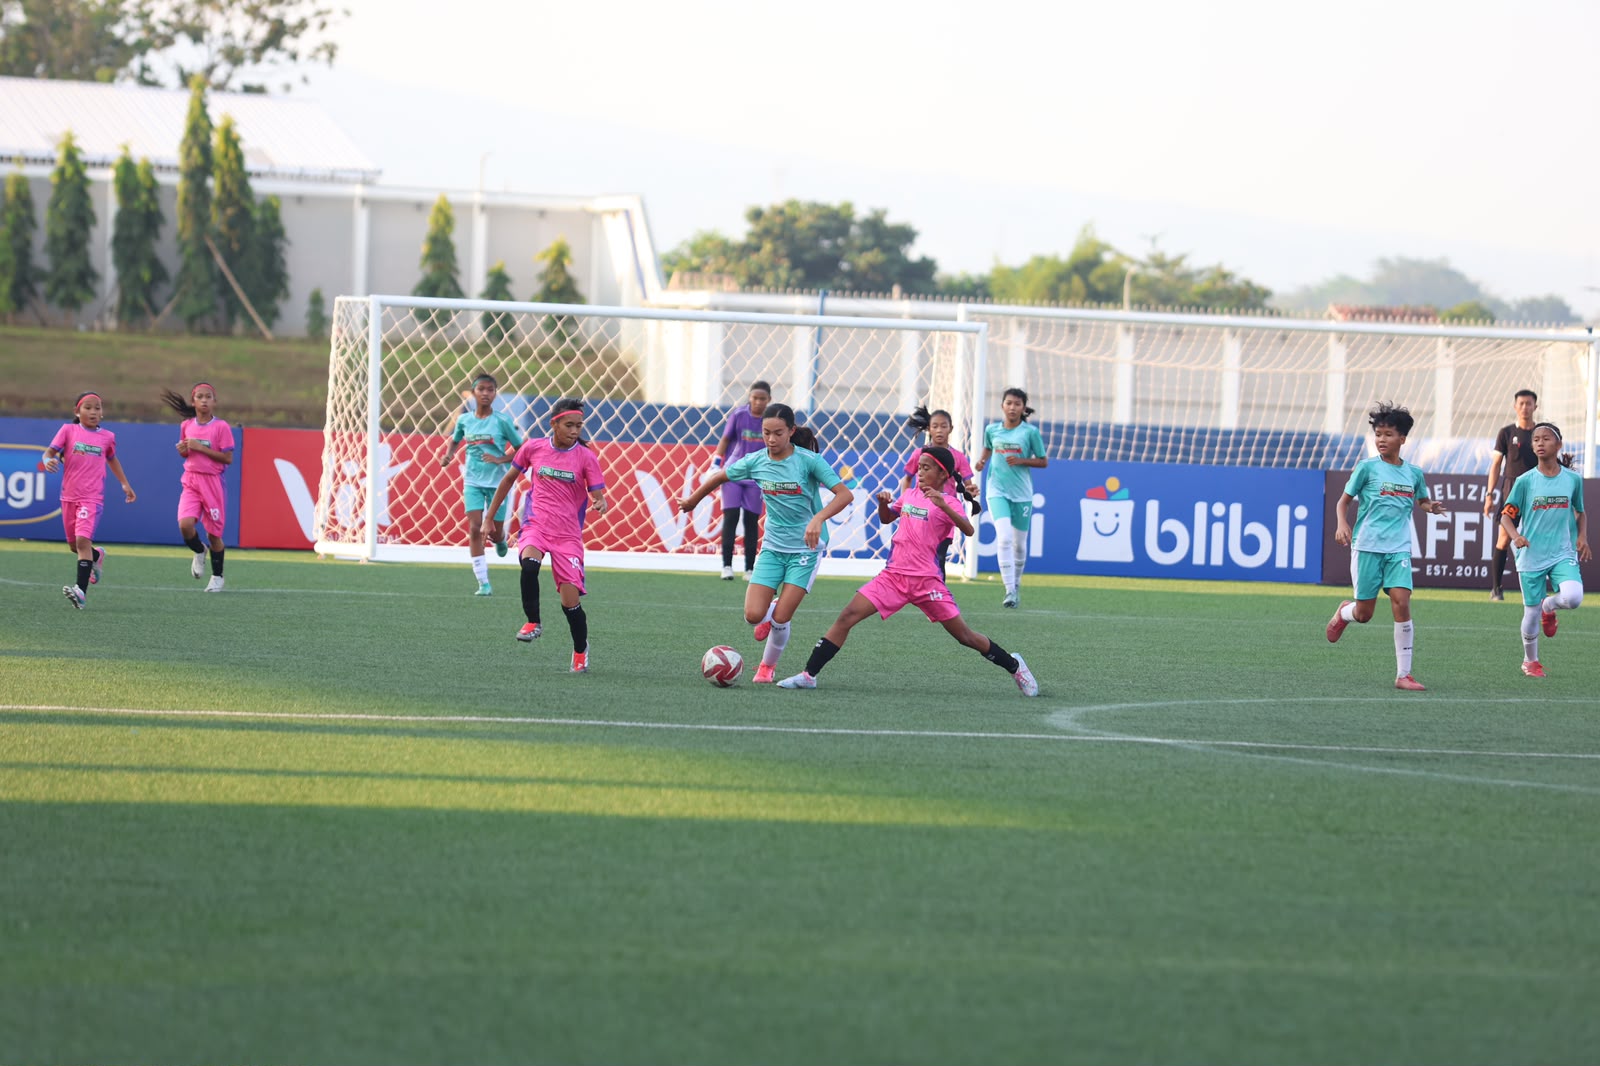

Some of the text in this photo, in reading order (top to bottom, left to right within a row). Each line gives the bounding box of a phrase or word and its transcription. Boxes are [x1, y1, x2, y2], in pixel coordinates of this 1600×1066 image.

[0, 461, 46, 509] gi
[1022, 505, 1030, 518] 2
[1145, 499, 1308, 569] blibli
[799, 555, 810, 567] 8
[1425, 564, 1488, 578] EST. 2018
